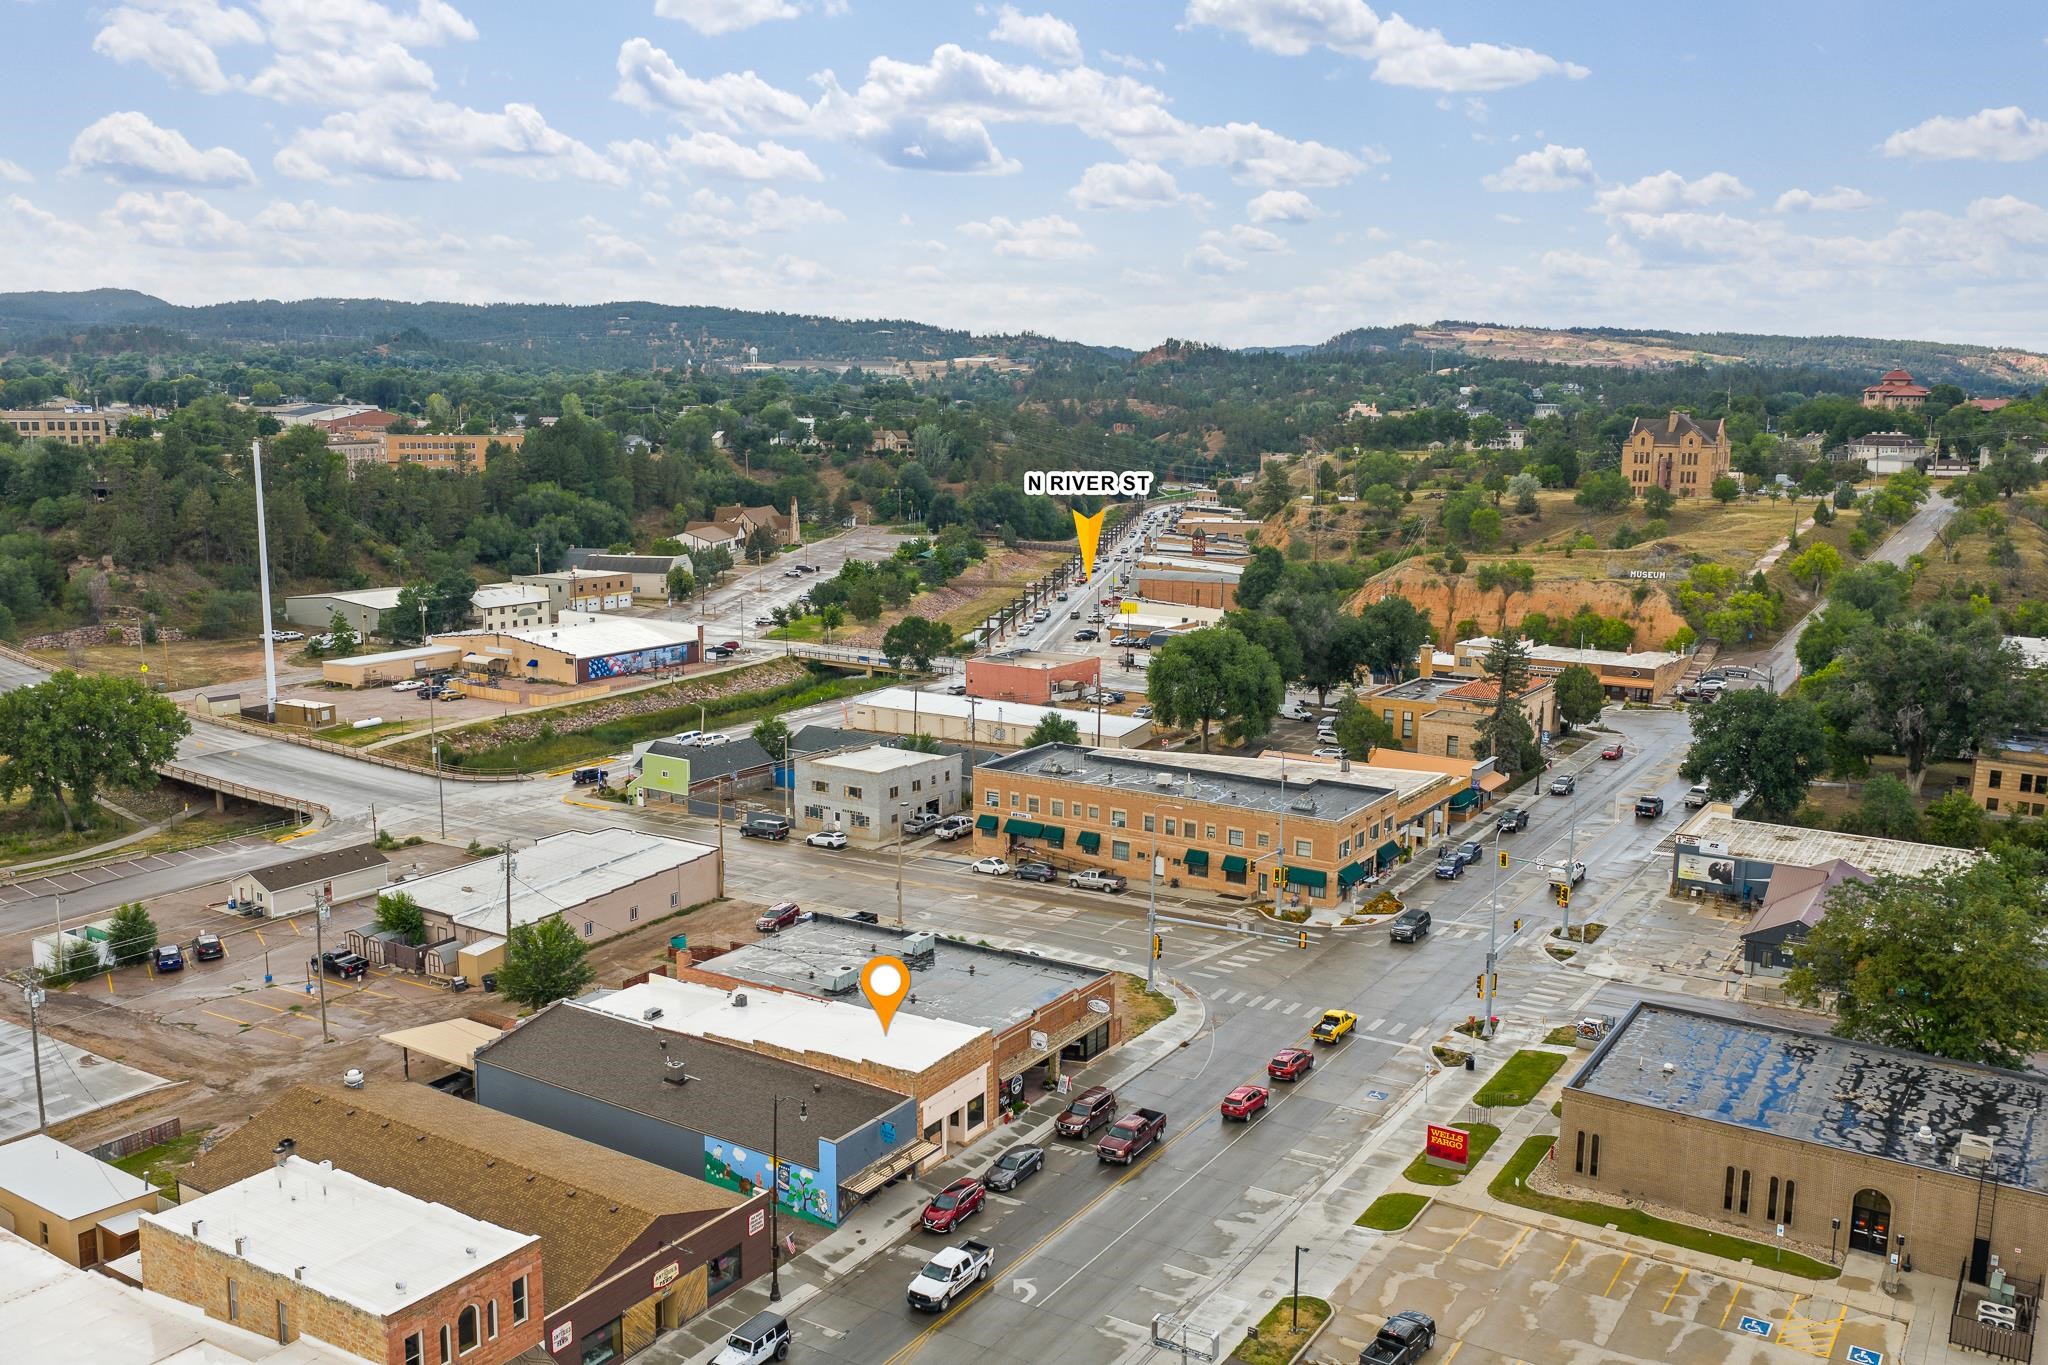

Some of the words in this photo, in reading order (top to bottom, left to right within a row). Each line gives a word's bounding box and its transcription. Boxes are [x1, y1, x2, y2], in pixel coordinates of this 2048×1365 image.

[1630, 570, 1666, 579] MUSEUM
[1431, 1128, 1464, 1143] WELLS
[1431, 1135, 1463, 1150] FARGO
